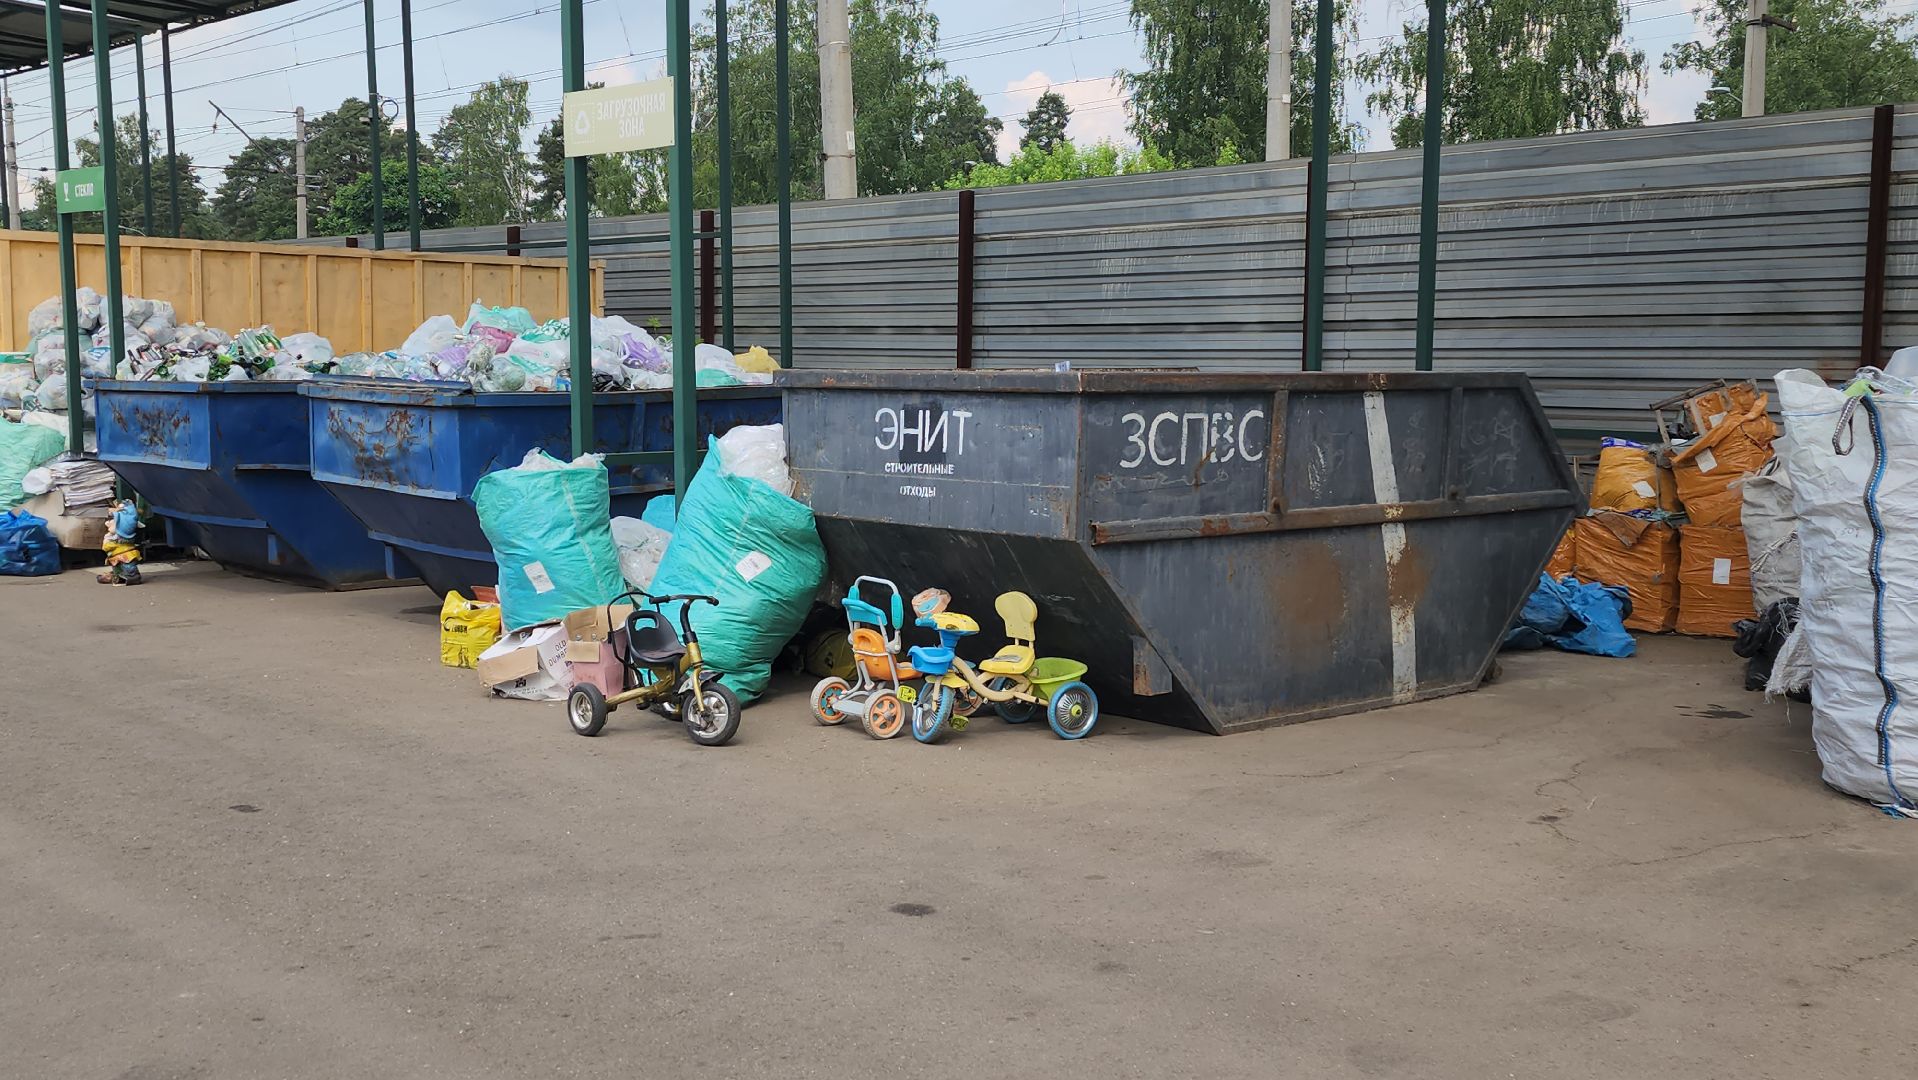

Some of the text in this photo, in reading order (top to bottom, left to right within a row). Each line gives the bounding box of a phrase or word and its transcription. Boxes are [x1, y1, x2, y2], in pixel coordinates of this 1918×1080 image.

[597, 92, 666, 120] ЗАГРУЗОЧНАЯ
[619, 116, 645, 138] ЗОНА
[875, 407, 973, 456] ЭНИТ
[884, 462, 956, 475] СТРОИТЕЛЬНЫЕ
[899, 485, 937, 498] ОТХОДЫ
[555, 640, 567, 652] OLD
